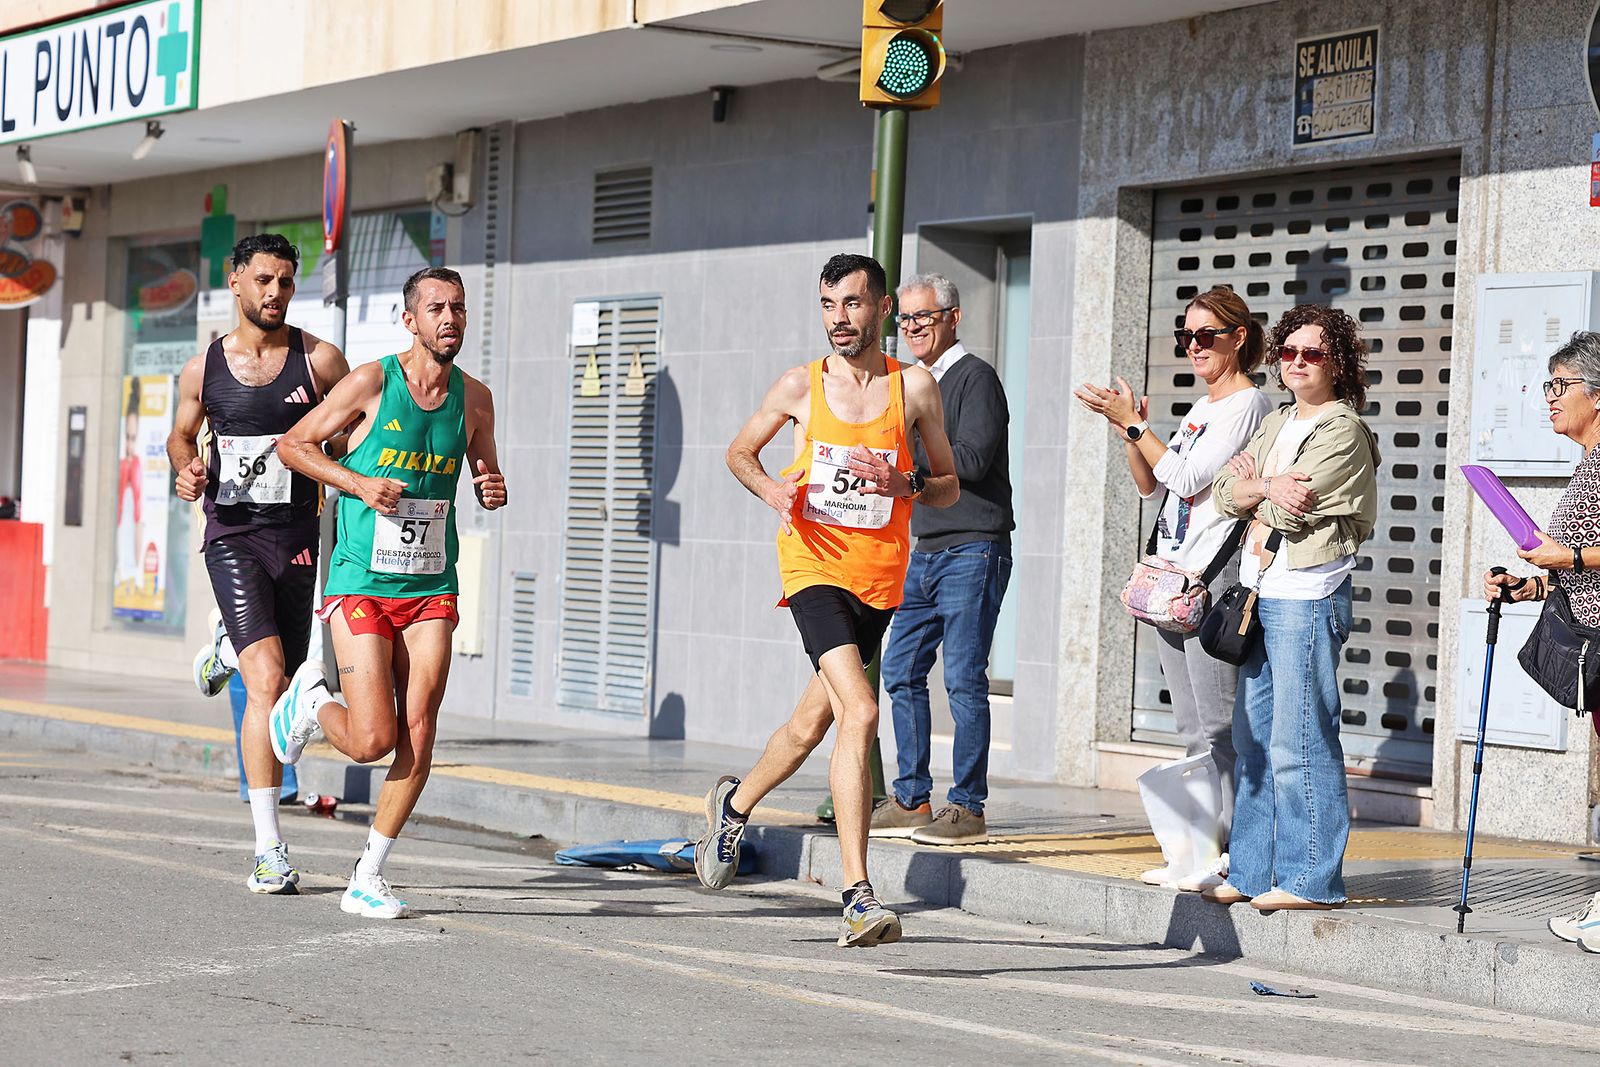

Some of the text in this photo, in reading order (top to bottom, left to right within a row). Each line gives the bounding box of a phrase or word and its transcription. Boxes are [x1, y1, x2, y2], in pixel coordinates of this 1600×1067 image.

[1299, 35, 1373, 78] SE ALQUILA
[34, 15, 150, 126] PUNTO
[221, 439, 234, 451] 2K
[818, 445, 833, 460] 2K
[238, 455, 267, 479] 56
[377, 447, 457, 475] BIKILA
[831, 468, 867, 497] 54
[434, 502, 446, 515] 2K
[806, 502, 844, 519] Huelva
[824, 499, 867, 512] MARHOUM
[400, 519, 431, 545] 57
[376, 548, 441, 559] CUESTAS CARDOZO
[376, 555, 411, 567] Huelva
